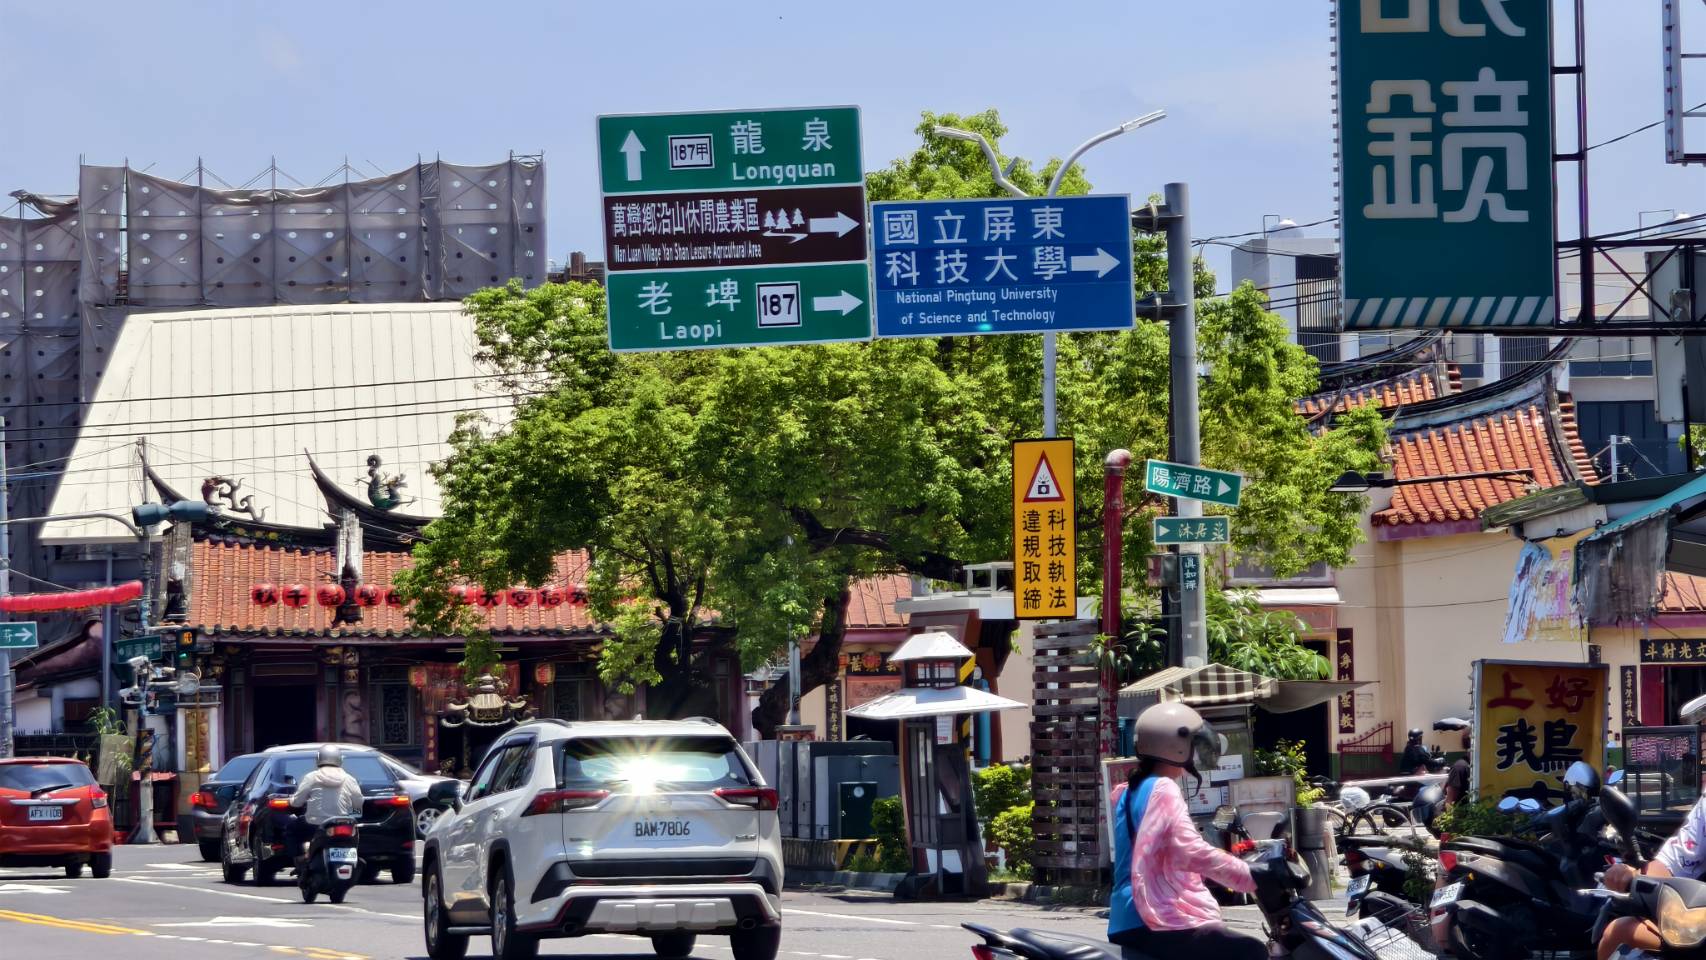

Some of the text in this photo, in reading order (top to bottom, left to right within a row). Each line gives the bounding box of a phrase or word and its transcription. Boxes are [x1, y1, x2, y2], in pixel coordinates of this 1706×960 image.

[1360, 0, 1529, 222] 鏡
[730, 117, 833, 155] 龍泉
[674, 143, 709, 161] 187甲
[733, 162, 835, 184] Longquan
[883, 205, 1065, 246] 國立屏東
[627, 244, 641, 262] Luan
[642, 243, 662, 266] Village
[674, 242, 690, 261] Shan
[690, 241, 712, 260] Leisure
[713, 240, 747, 264] Agricultural
[748, 240, 762, 258] Area
[886, 246, 1068, 286] 科技大學
[637, 278, 741, 316] 老埤
[762, 294, 795, 316] 187
[897, 286, 1058, 305] National Pingtung University
[901, 308, 1056, 325] of Science and Technology
[660, 320, 722, 342] Laopi
[1152, 467, 1213, 496] 陽濟路
[1022, 509, 1041, 610] 違規取締
[1048, 508, 1067, 608] 科技執法
[634, 820, 690, 837] BAM-7806
